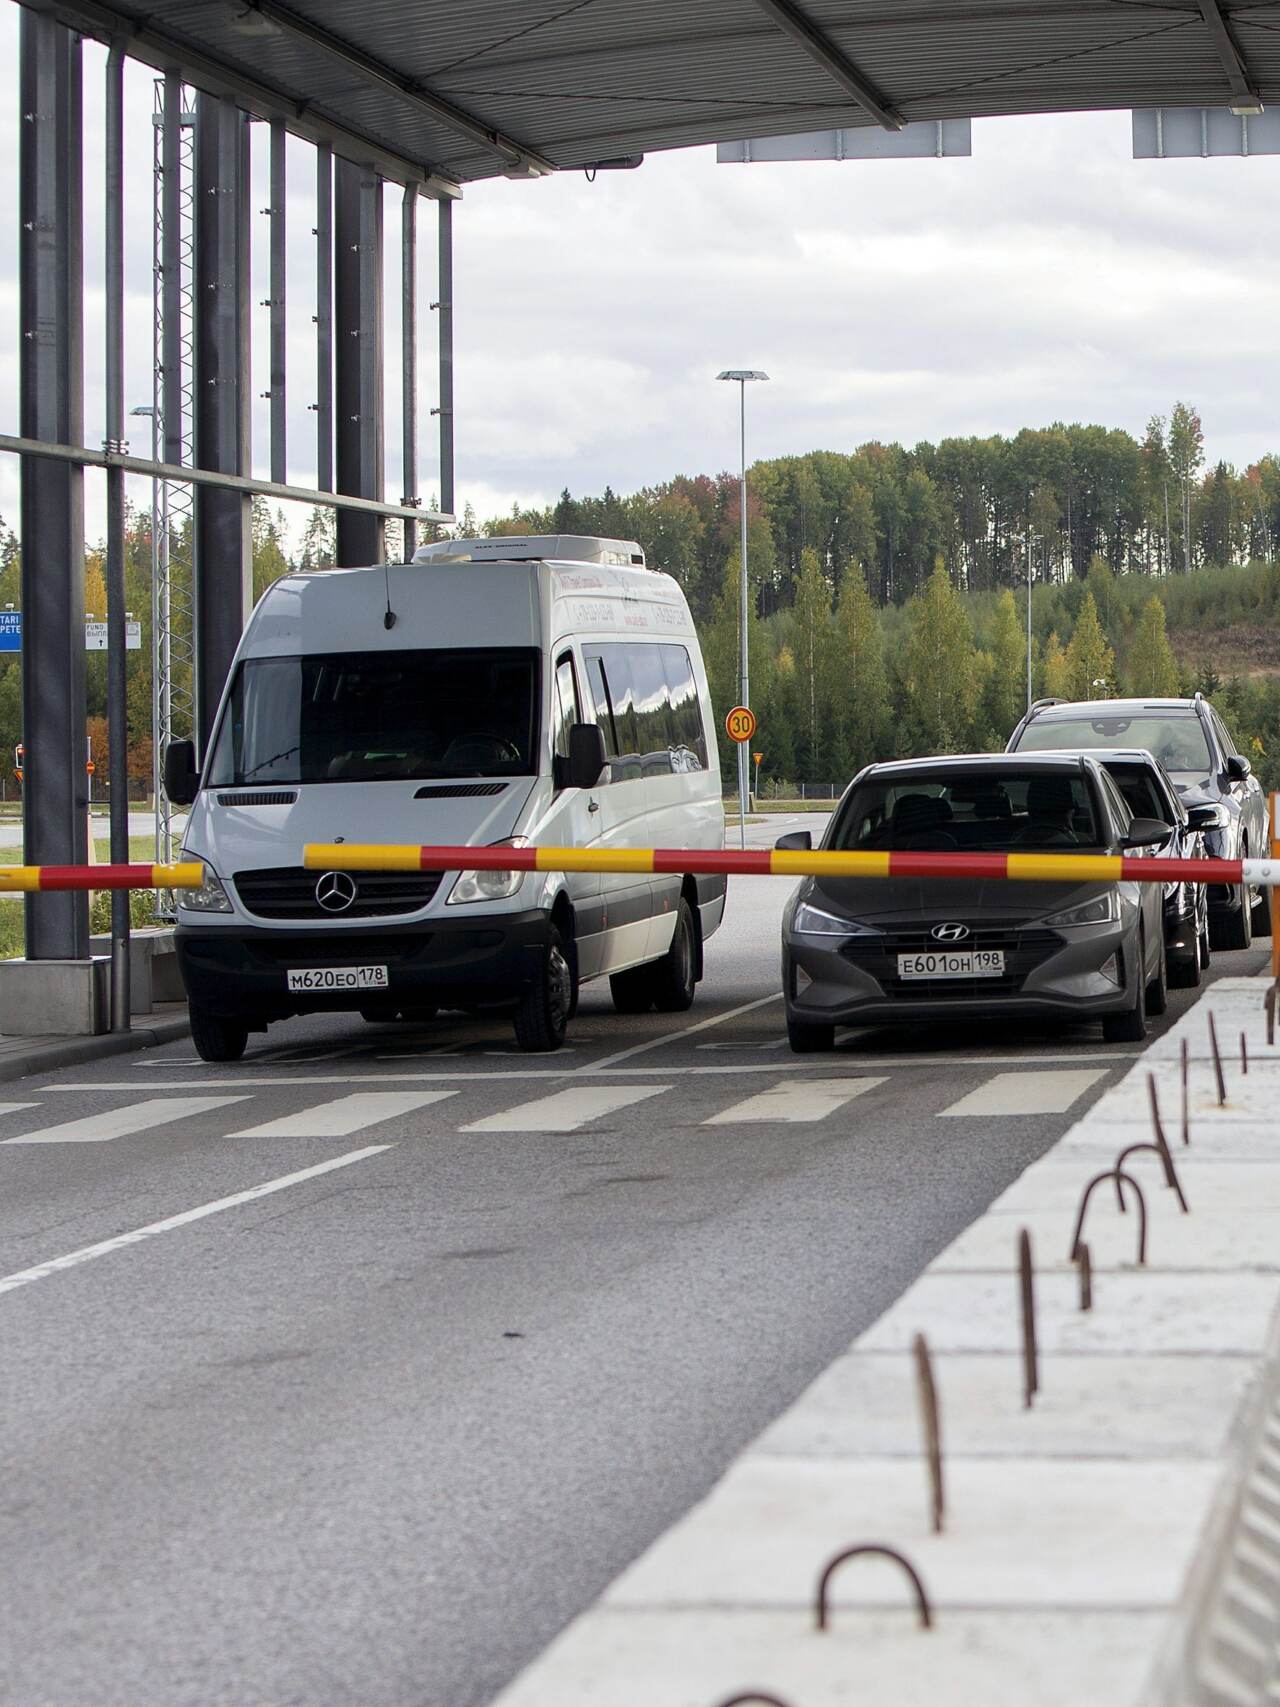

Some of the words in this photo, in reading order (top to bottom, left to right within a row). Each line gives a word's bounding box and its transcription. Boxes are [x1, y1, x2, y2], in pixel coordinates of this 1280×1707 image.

[732, 716, 750, 733] 30
[974, 953, 1000, 966] 198
[359, 968, 383, 980] 178
